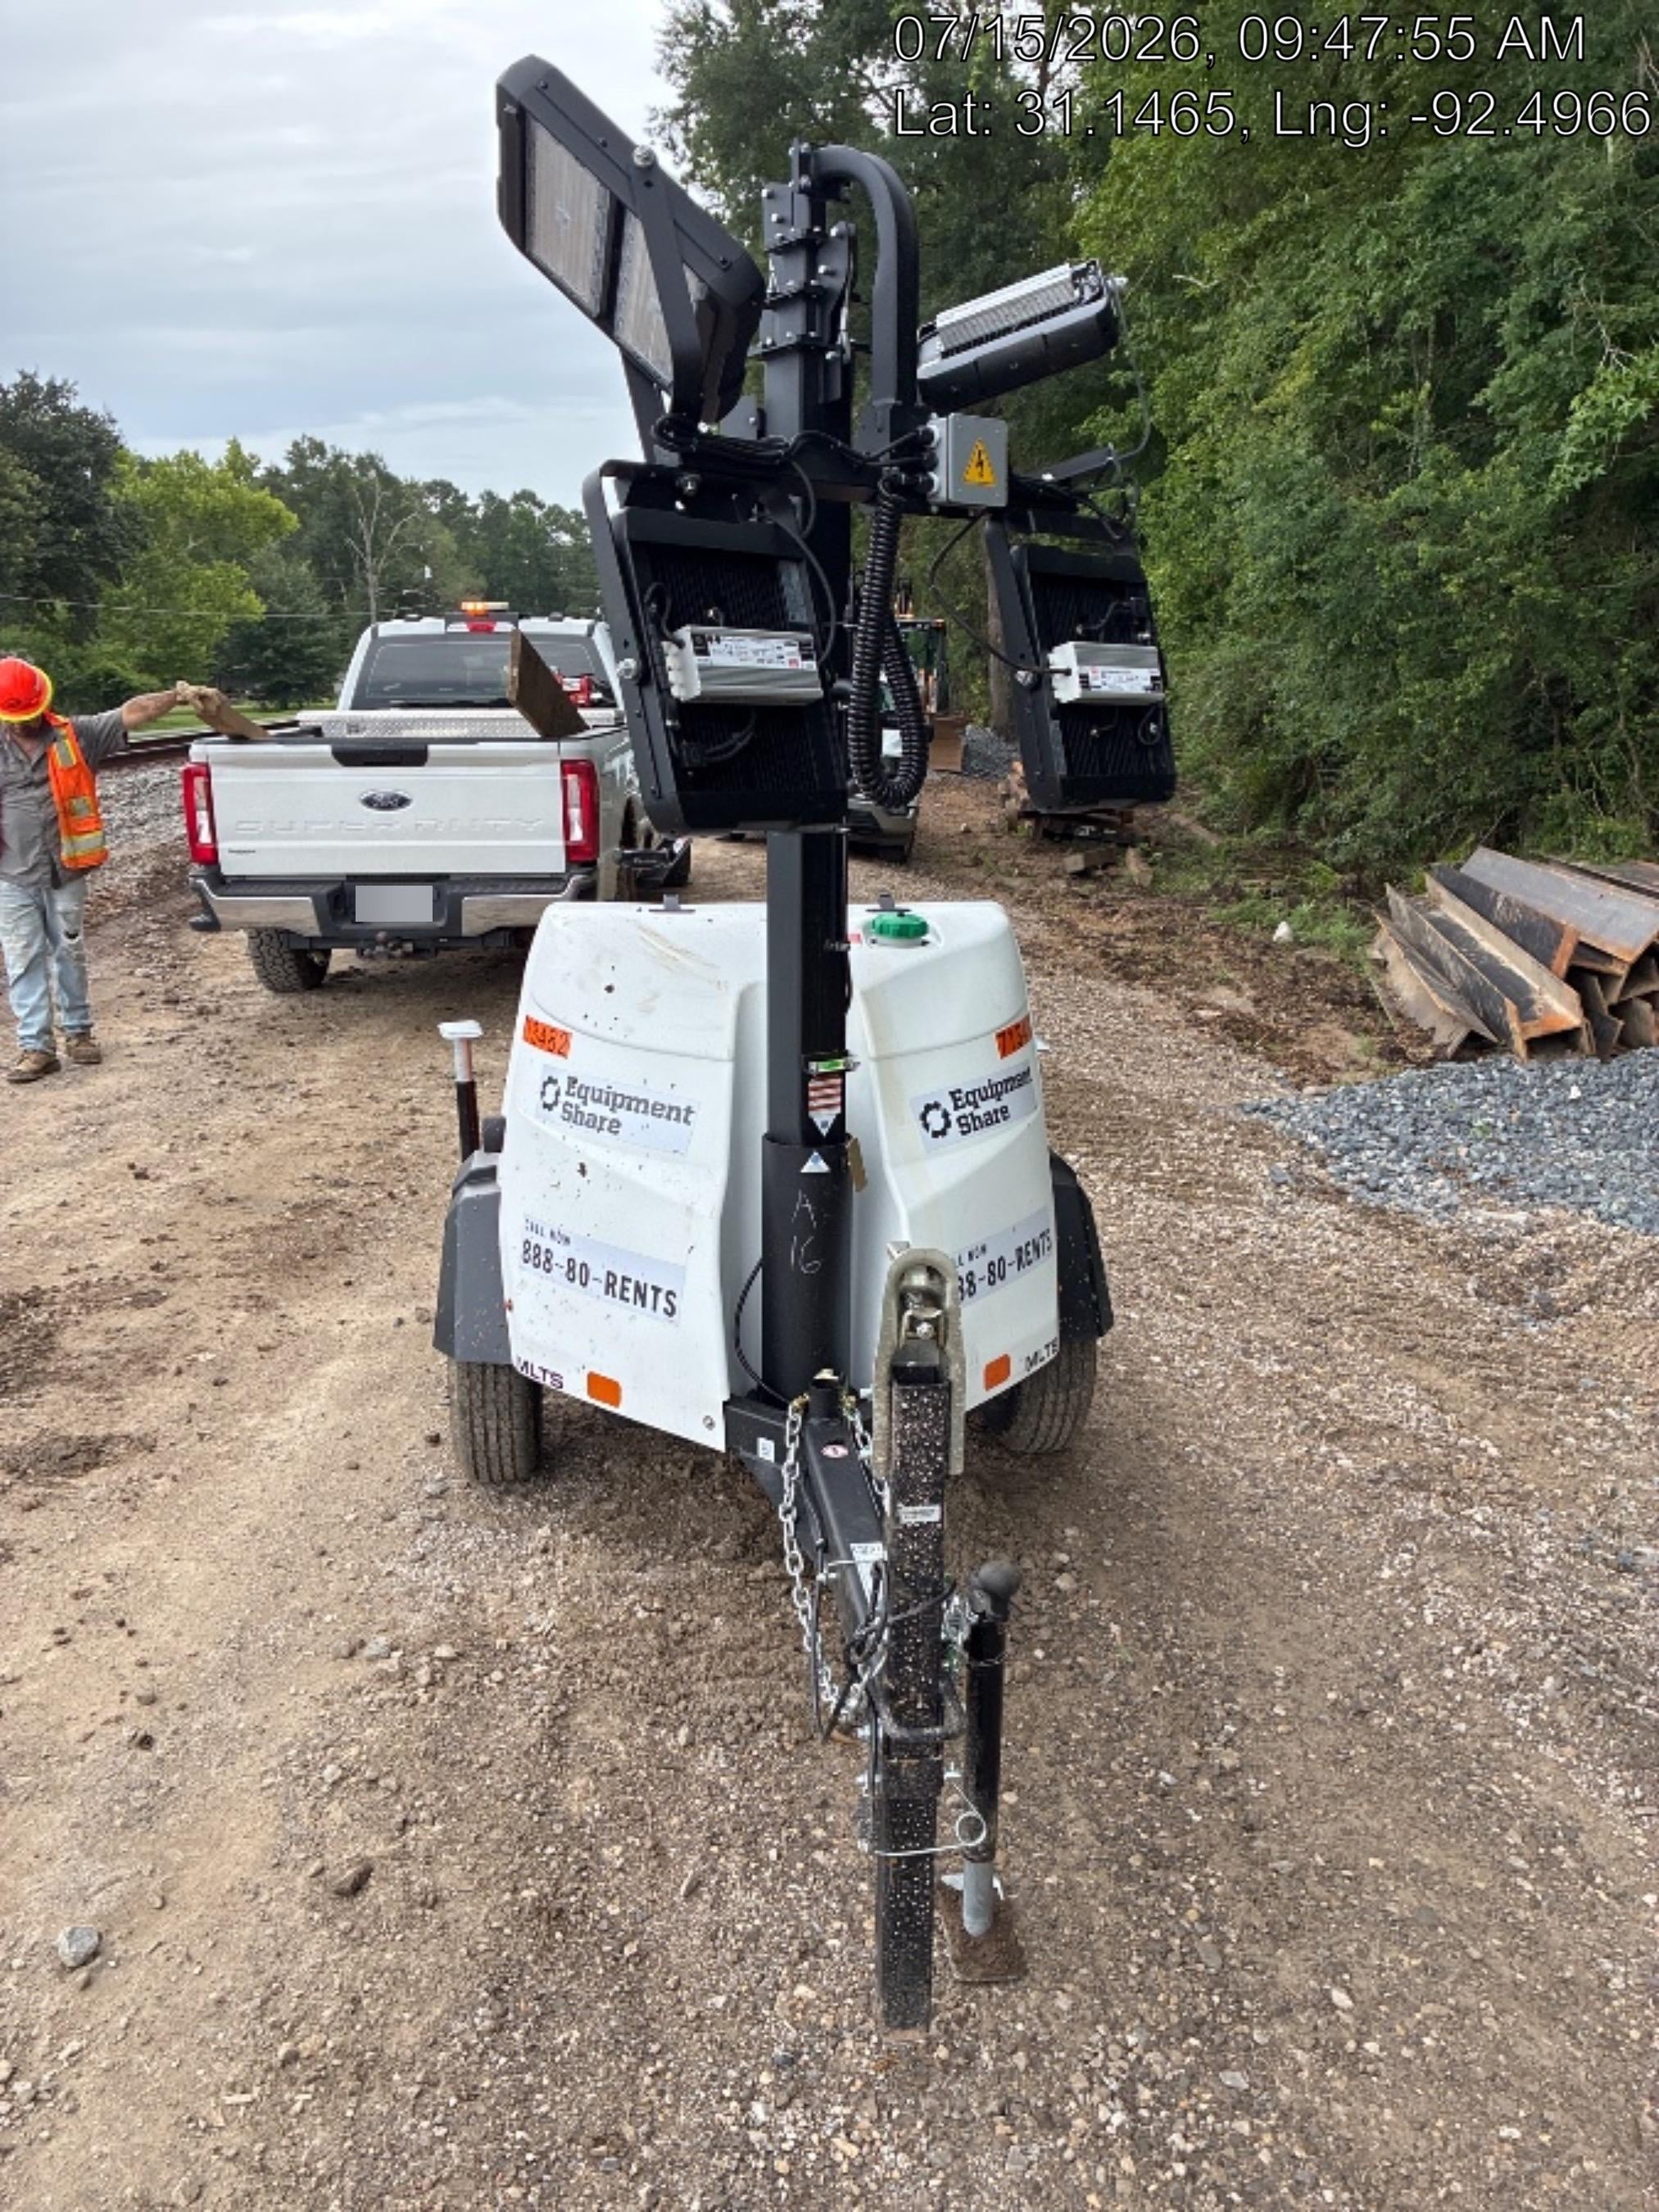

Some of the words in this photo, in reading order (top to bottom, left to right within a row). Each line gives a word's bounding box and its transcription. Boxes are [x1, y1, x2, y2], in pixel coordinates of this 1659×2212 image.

[561, 1101, 622, 1135] Share
[565, 1076, 696, 1126] Equipment
[956, 1105, 1010, 1135] Share
[522, 1238, 678, 1317] 888-80-RENTS
